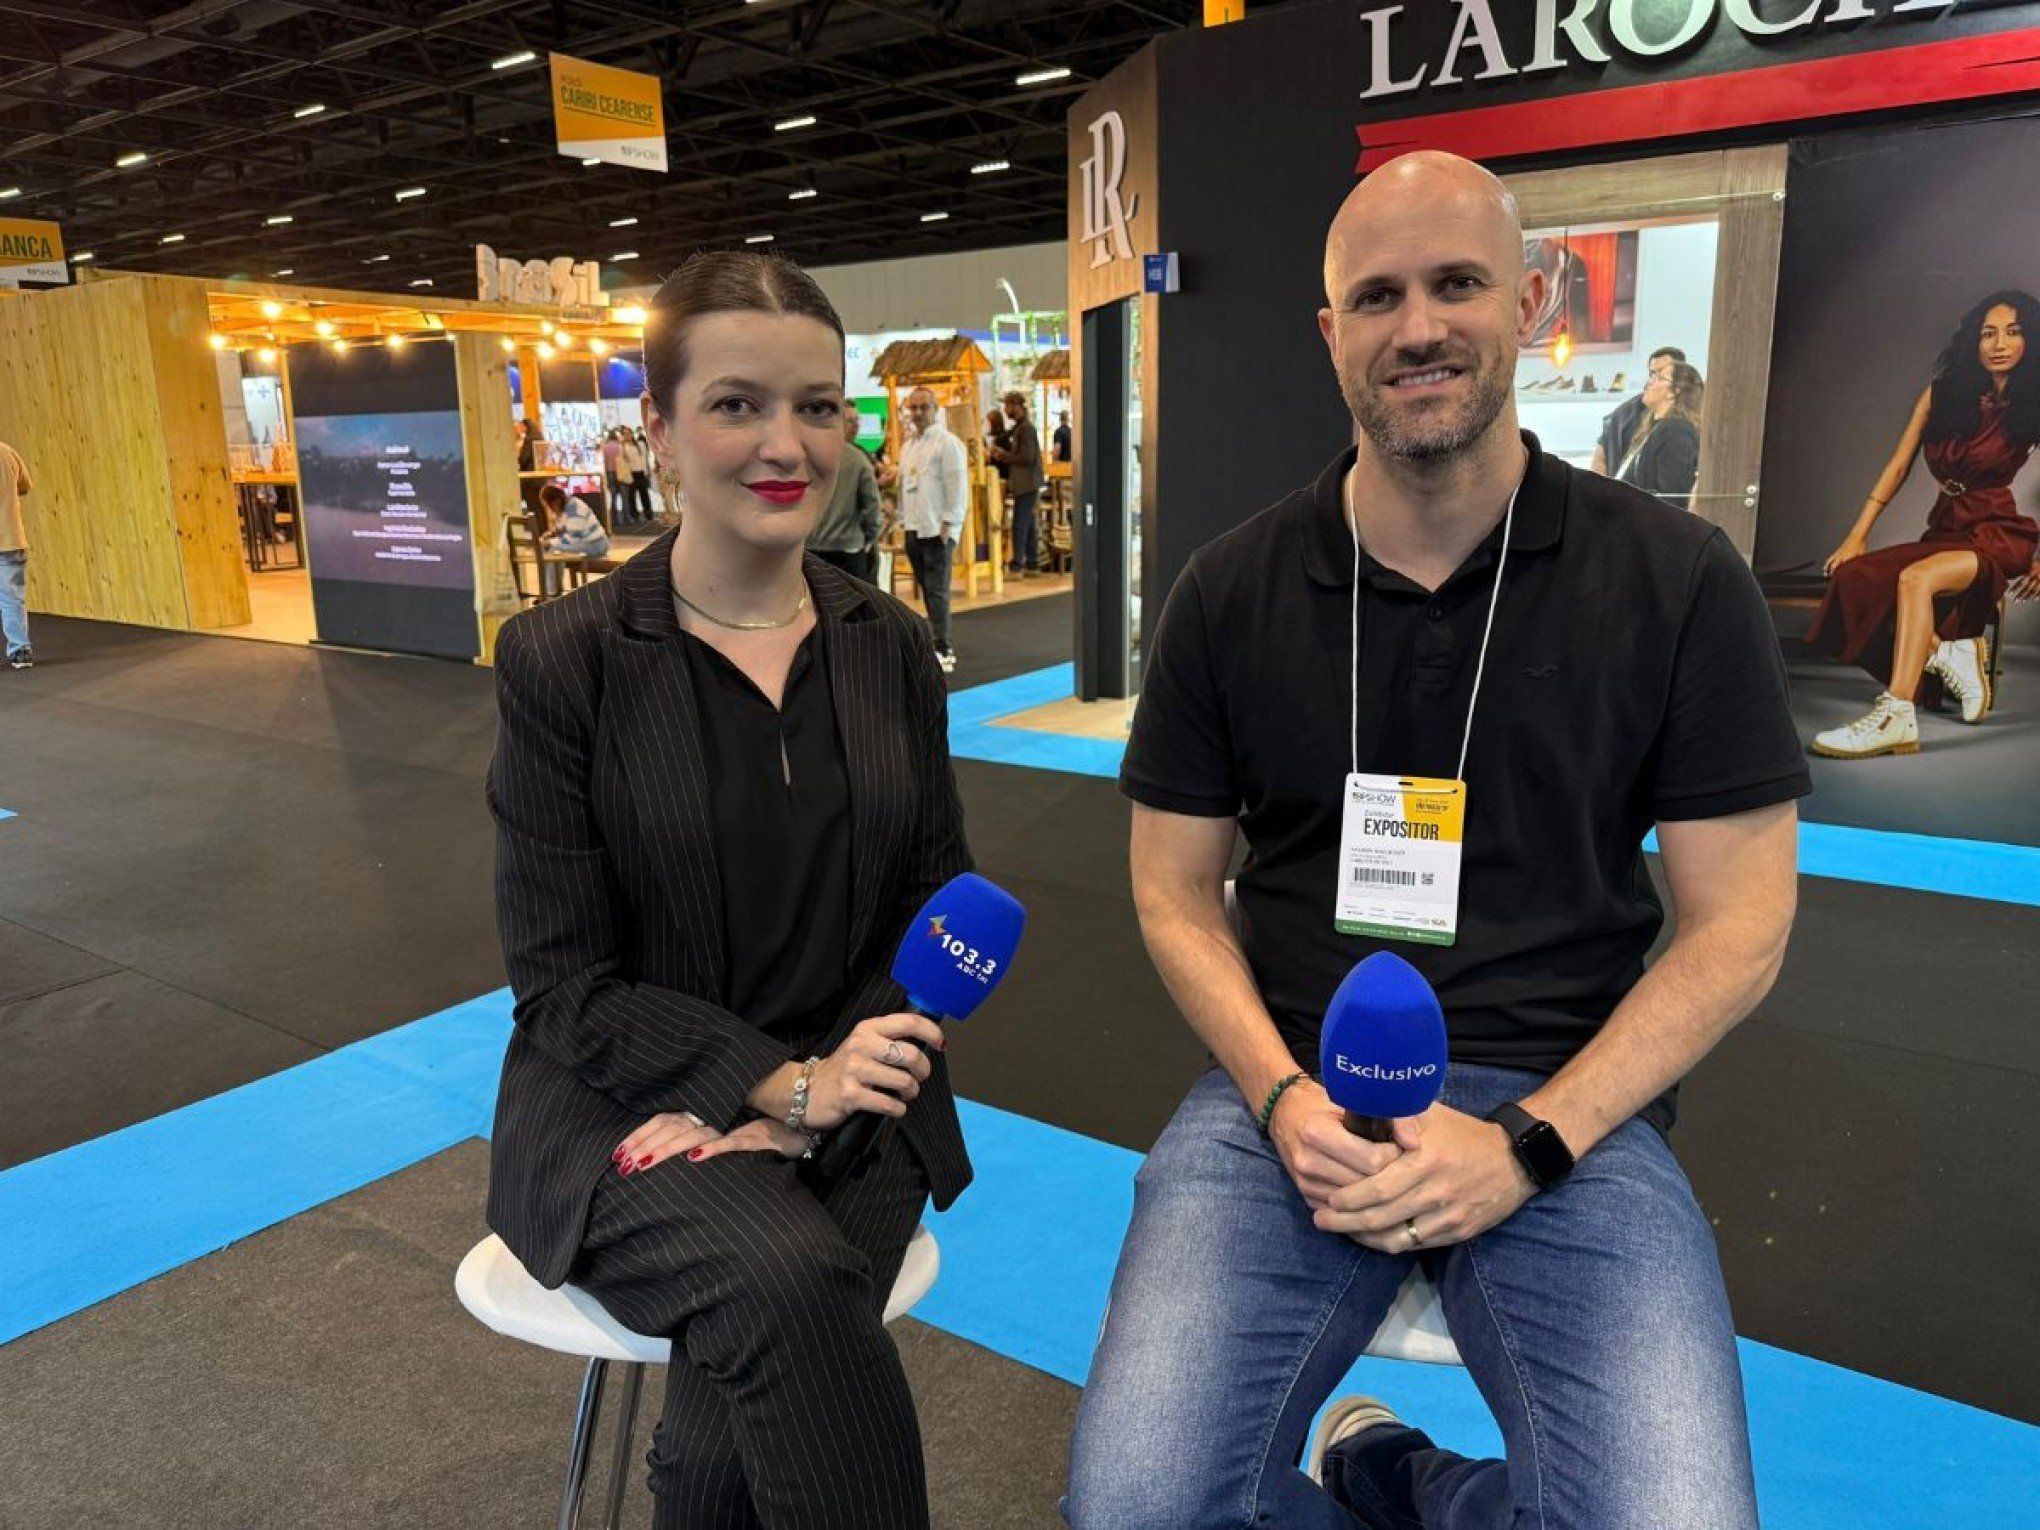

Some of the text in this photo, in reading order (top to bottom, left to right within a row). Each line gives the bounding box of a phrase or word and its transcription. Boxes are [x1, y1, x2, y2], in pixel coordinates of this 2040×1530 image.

[0, 233, 53, 260] ANCA
[1364, 818, 1439, 841] EXPOSITOR
[942, 934, 997, 975] 103.3
[1335, 1053, 1437, 1082] Exclusivo
